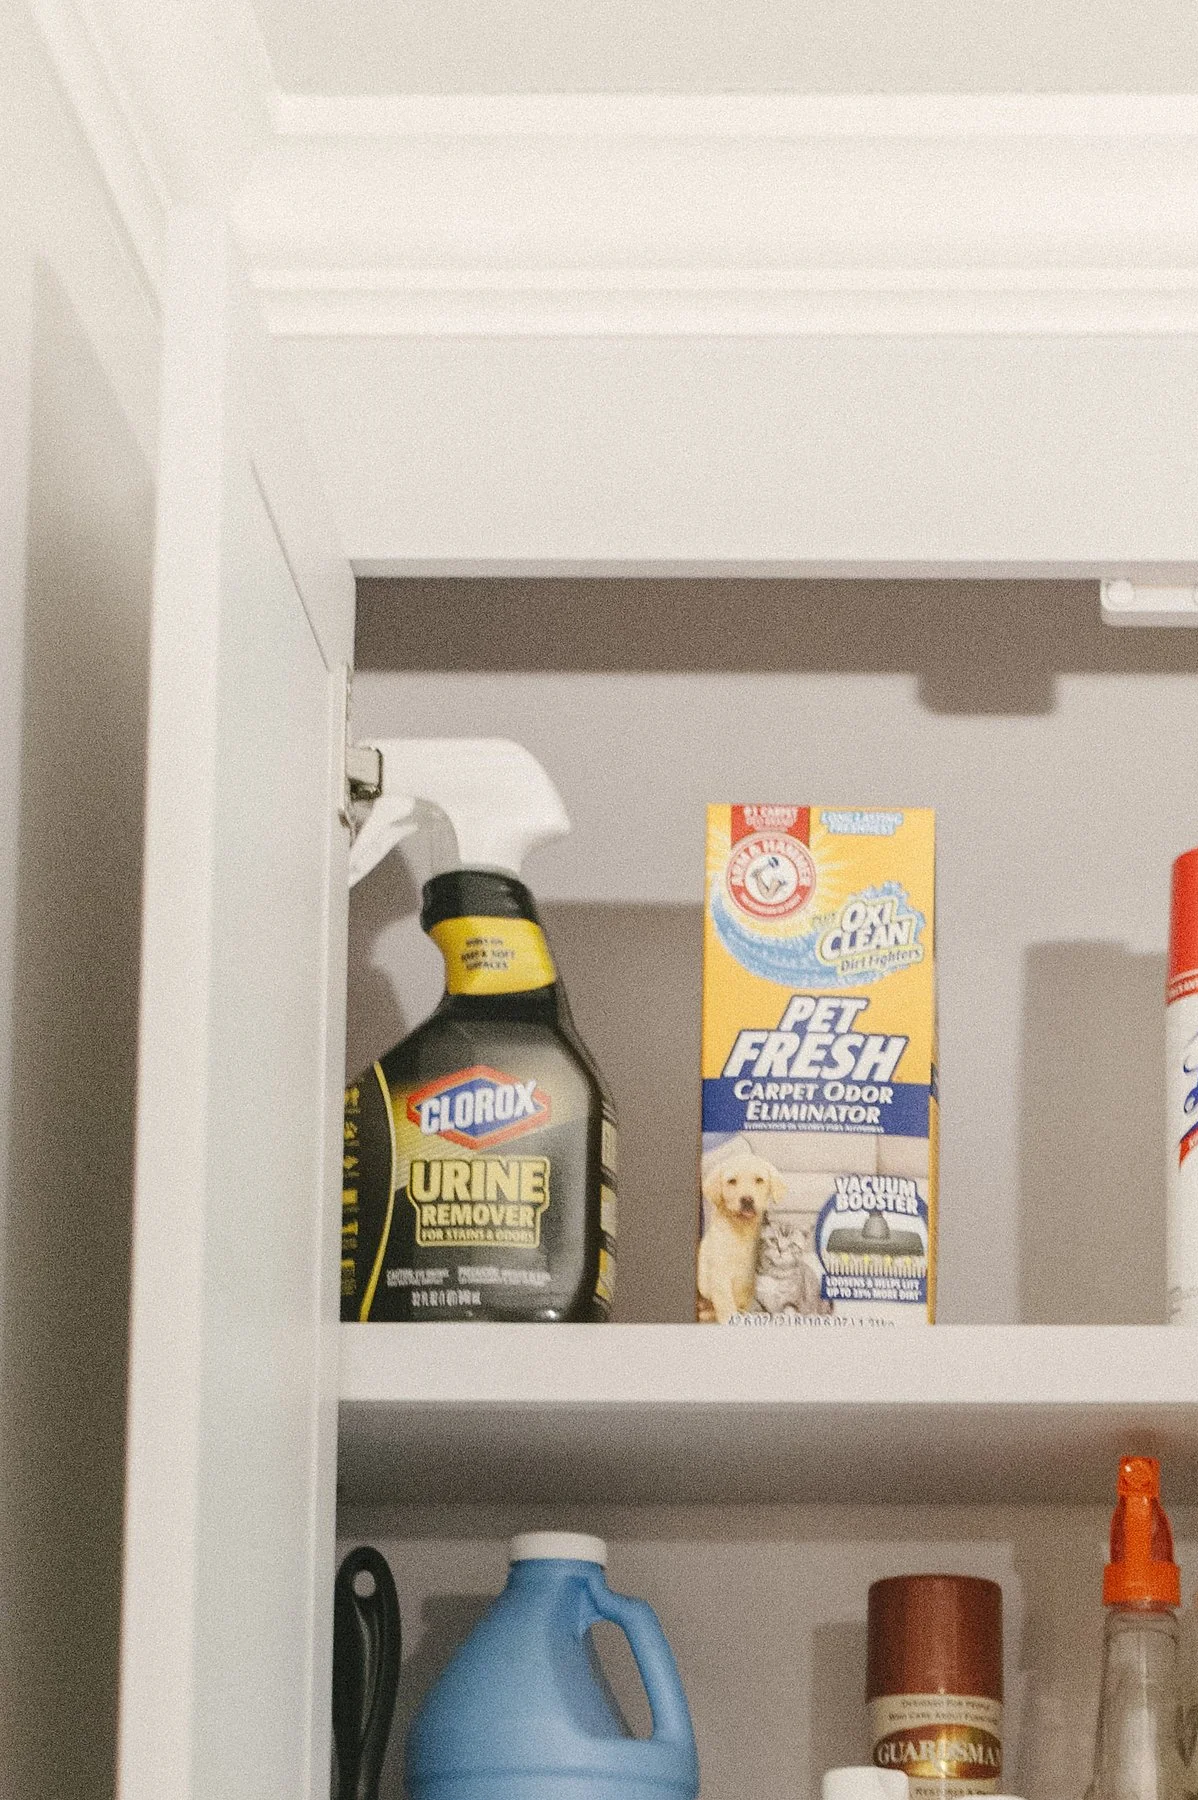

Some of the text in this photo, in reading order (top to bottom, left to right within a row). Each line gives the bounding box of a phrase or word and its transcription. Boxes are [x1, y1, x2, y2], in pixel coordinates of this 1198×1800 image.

[842, 898, 893, 932] OXI
[821, 919, 912, 961] CLEAN
[778, 995, 869, 1034] PET
[723, 1029, 910, 1082] FRESH
[419, 1079, 538, 1135] CLOROX
[733, 1080, 894, 1105] CARPET ODOR
[746, 1100, 882, 1125] ELIMINATOR
[411, 1160, 544, 1203] URINE
[834, 1176, 917, 1197] VACUUM
[421, 1203, 535, 1228] REMOVER
[835, 1192, 918, 1215] BOOSTER
